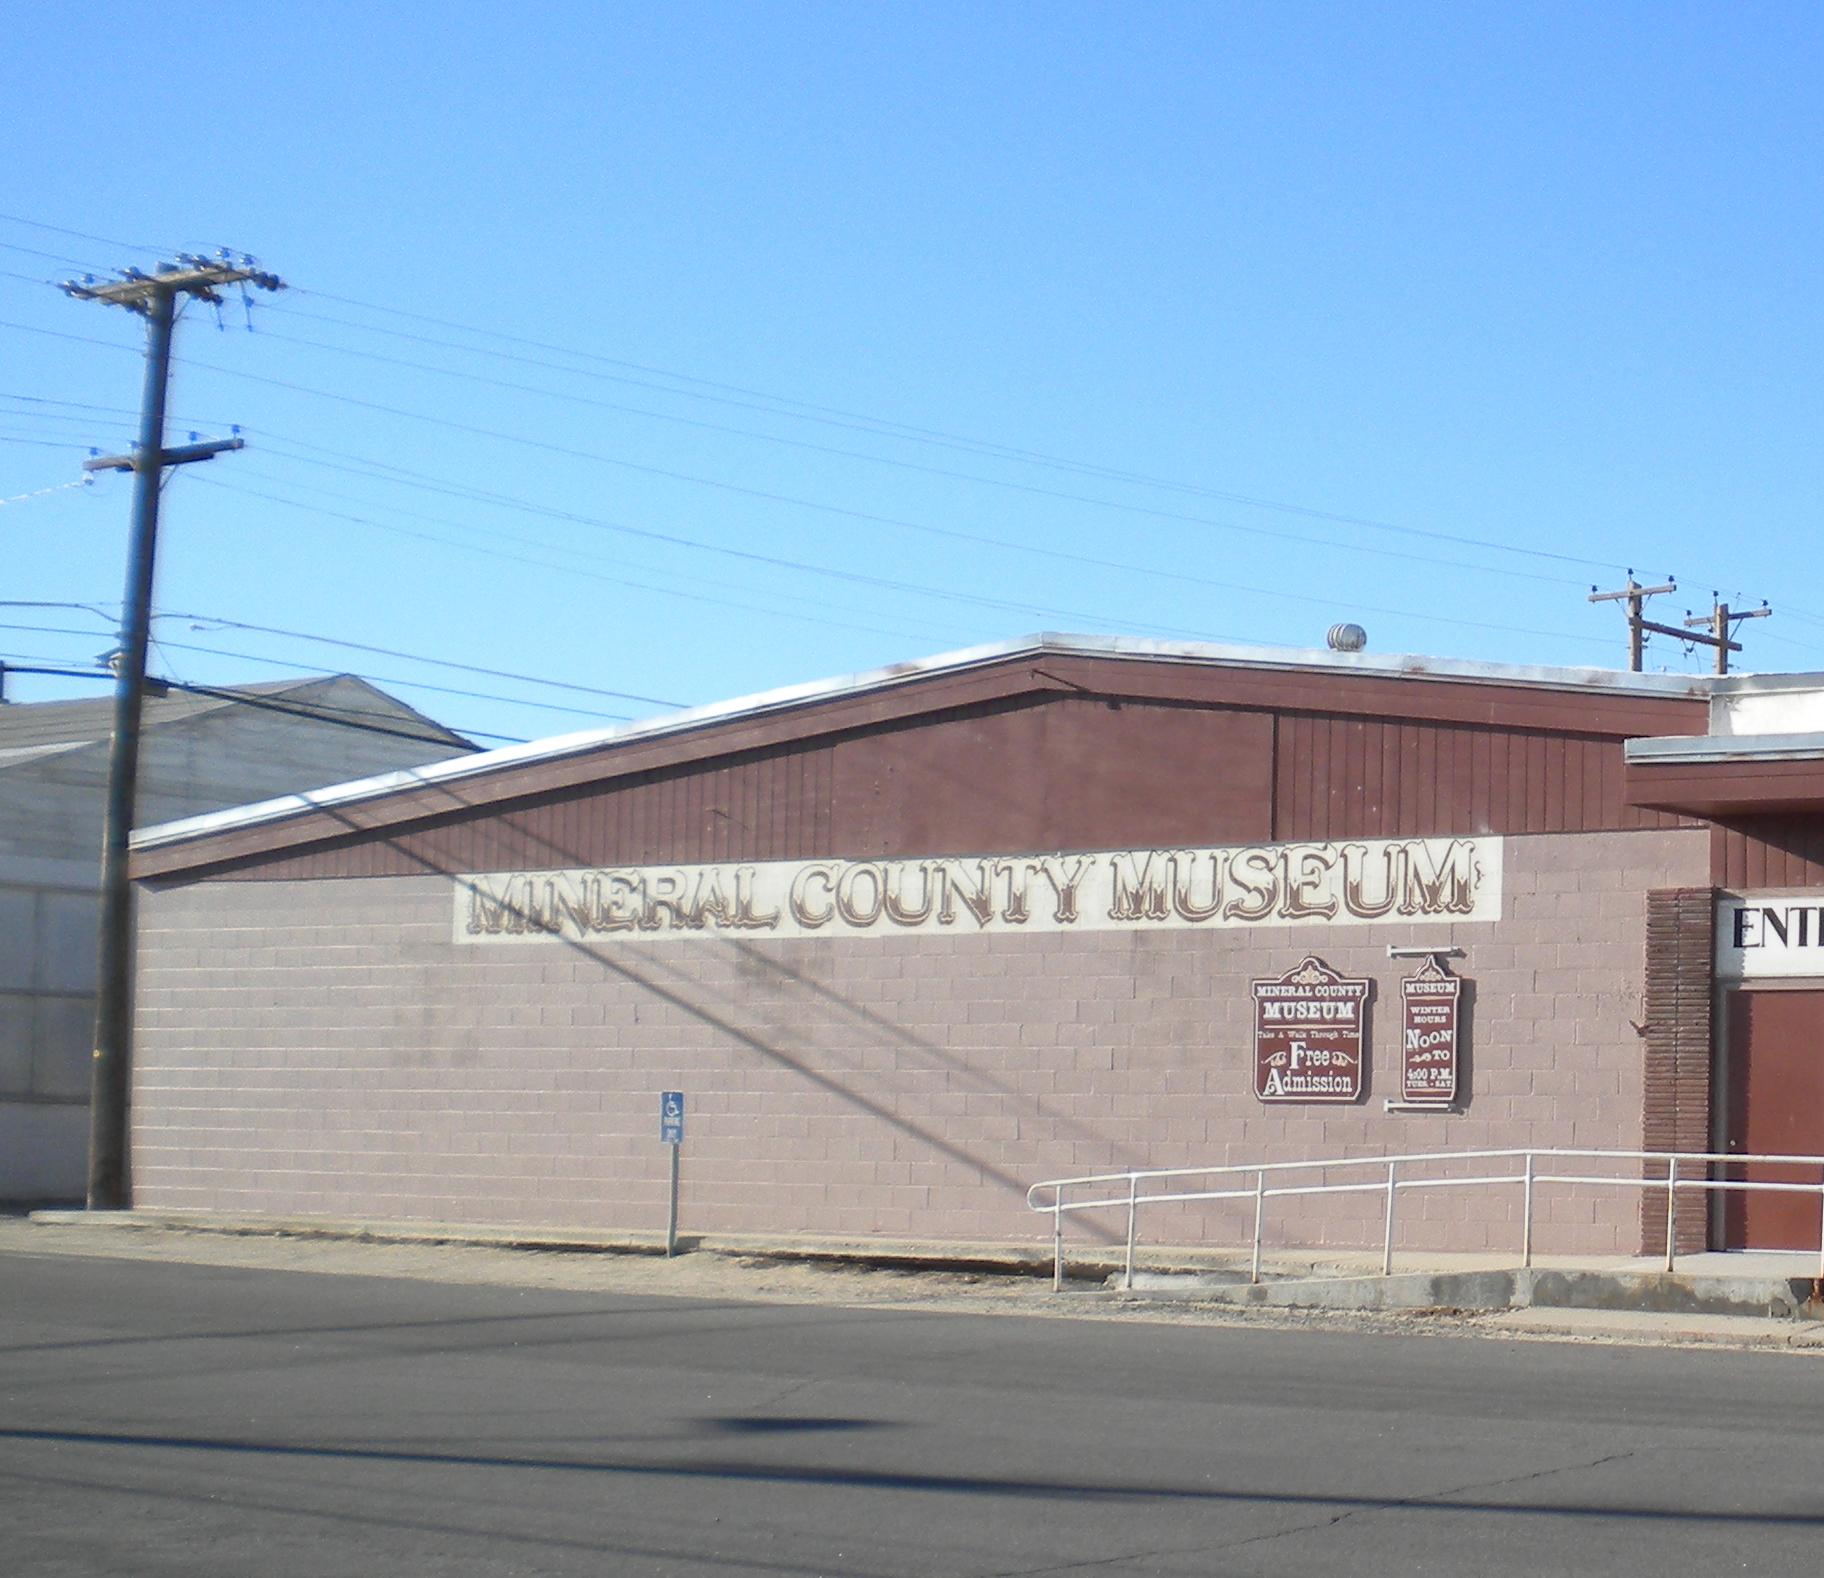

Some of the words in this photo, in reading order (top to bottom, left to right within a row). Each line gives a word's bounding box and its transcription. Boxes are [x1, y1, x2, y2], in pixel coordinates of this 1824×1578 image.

[465, 866, 781, 938] MINERAL
[789, 853, 1096, 929] COUNTY
[1108, 839, 1475, 922] MUSEUM
[1256, 985, 1313, 997] MINERAL
[1314, 985, 1363, 997] COUNTY
[1405, 982, 1455, 993] MUSEUM
[1262, 1001, 1355, 1020] MUSEUM
[1410, 1006, 1451, 1014] WINTER
[1413, 1015, 1447, 1024] HOURS
[1288, 1041, 1330, 1070] Free
[1432, 1049, 1450, 1061] TO
[1262, 1067, 1353, 1096] Admission
